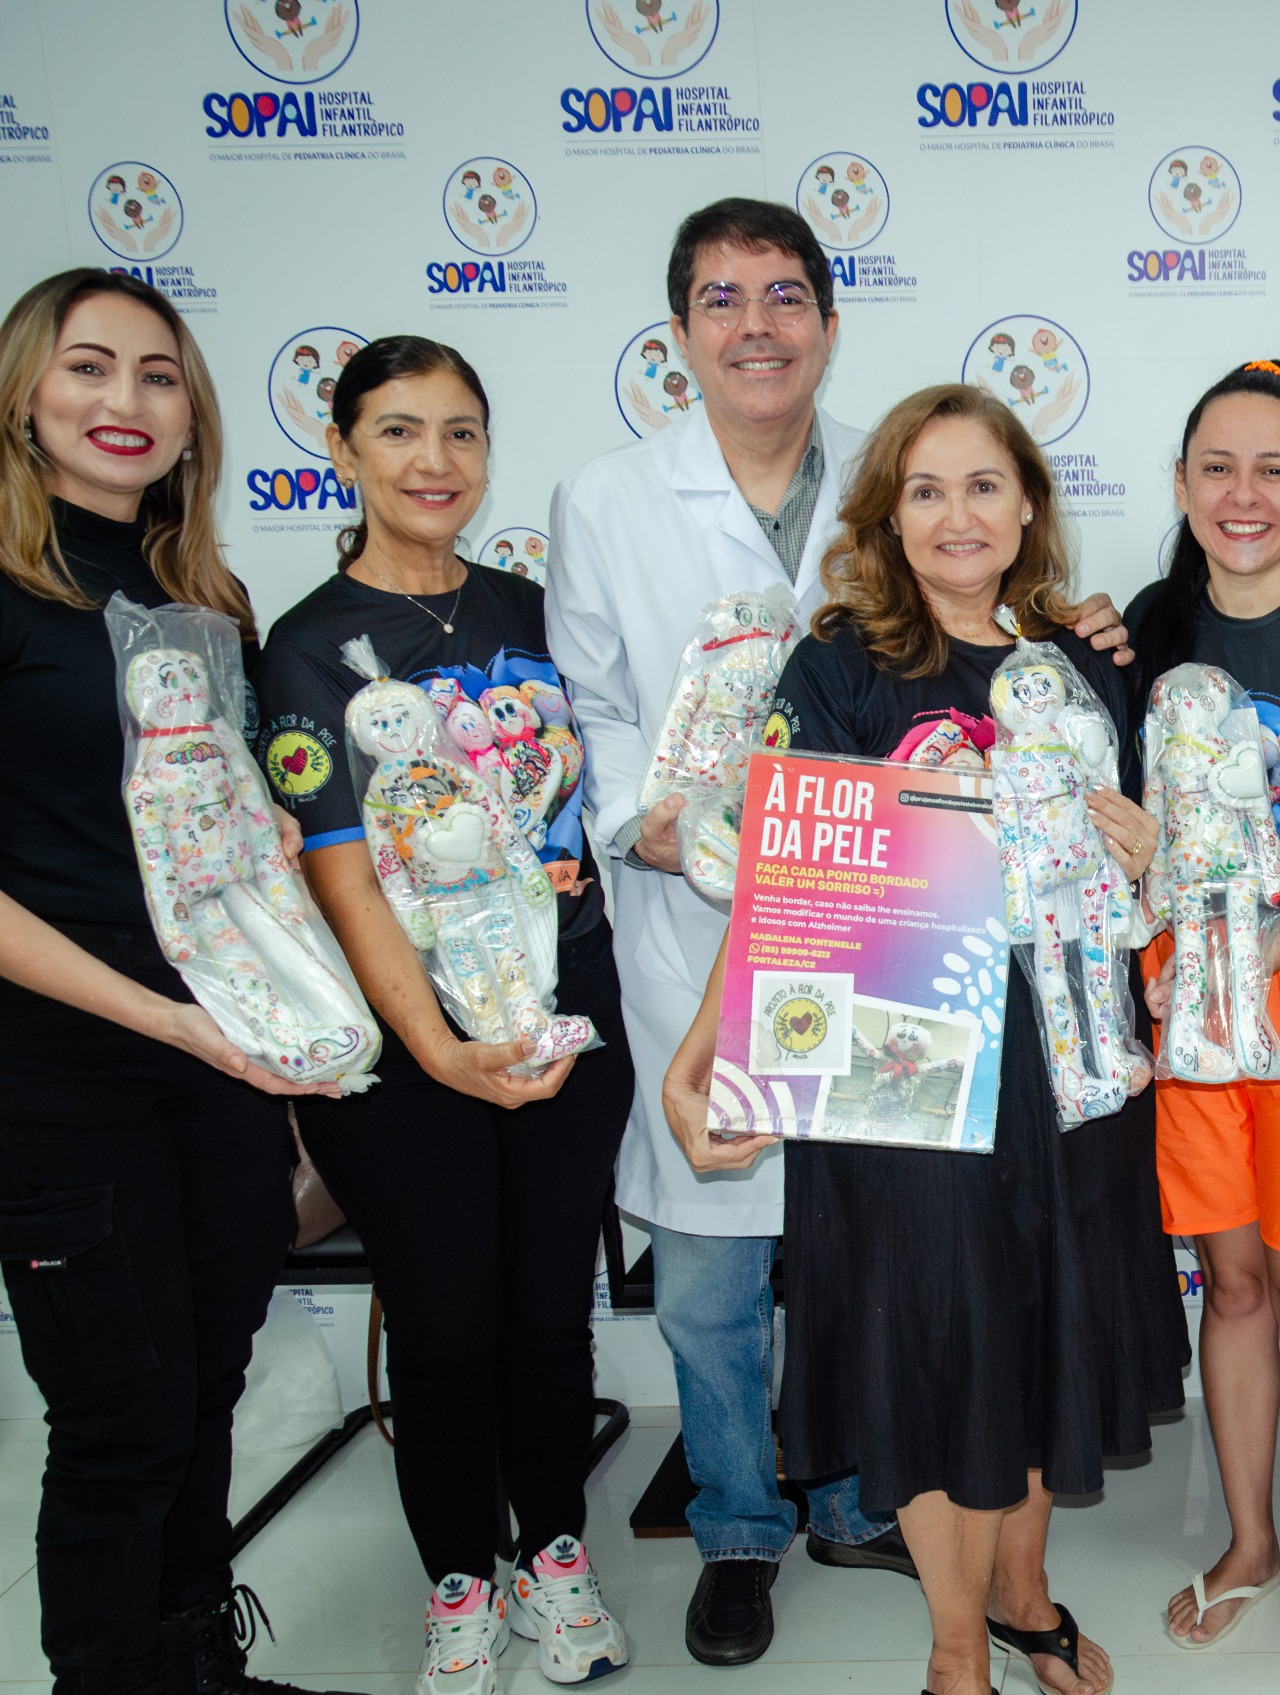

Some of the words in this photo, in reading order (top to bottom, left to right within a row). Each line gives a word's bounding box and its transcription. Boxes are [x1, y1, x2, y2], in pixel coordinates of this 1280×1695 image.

[676, 86, 730, 100] HOSPITAL
[1032, 81, 1086, 94] HOSPITAL
[319, 91, 374, 106] HOSPITAL
[917, 81, 1027, 127] SOPAI
[1032, 98, 1084, 110] INFANTIL
[203, 92, 318, 138] SOPAI
[320, 107, 372, 120] INFANTIL
[561, 87, 673, 132] SOPAI
[678, 103, 728, 115] INFANTIL
[679, 114, 760, 131] FILANTRÓPICO
[1033, 109, 1114, 126] FILANTRÓPICO
[322, 119, 404, 137] FILANTRÓPICO
[572, 147, 599, 155] MAIOR
[600, 147, 635, 155] HOSPITAL
[636, 147, 648, 155] DE
[648, 146, 690, 155] PEDIATRIA
[690, 145, 721, 154] CLÍNICA
[722, 146, 735, 154] DO
[735, 145, 760, 154] BRASIL
[927, 143, 953, 151] MAIOR
[954, 142, 990, 151] HOSPITAL
[991, 142, 1002, 150] DE
[1003, 141, 1044, 150] PEDIATRIA
[1044, 140, 1075, 149] CLÍNICA
[1076, 141, 1088, 149] DO
[1089, 140, 1114, 149] BRASIL
[858, 255, 896, 265] HOSPITAL
[1208, 249, 1247, 259] HOSPITAL
[156, 266, 195, 276] HOSPITAL
[507, 261, 546, 271] HOSPITAL
[859, 267, 894, 275] INFANTIL
[1127, 249, 1205, 282] SOPAI
[1208, 260, 1245, 270] INFANTIL
[426, 261, 505, 294] SOPAI
[508, 272, 545, 281] INFANTIL
[860, 274, 917, 286] FILANTRÓPICO
[1208, 269, 1266, 280] FILANTRÓPICO
[157, 278, 194, 287] INFANTIL
[509, 280, 566, 292] FILANTRÓPICO
[286, 524, 320, 532] HOSPITAL
[279, 713, 298, 728] FLOR
[301, 717, 314, 731] DA
[318, 728, 336, 748] PELE
[764, 763, 786, 812] À
[796, 775, 874, 821] FLOR
[760, 816, 802, 860] DA
[812, 822, 890, 868] PELE
[756, 862, 788, 876] FAÇA
[791, 866, 824, 879] CADA
[827, 869, 867, 883] PONTO
[870, 874, 928, 889] BORDADO
[755, 874, 794, 887] VALER
[797, 878, 815, 889] UM
[818, 880, 871, 895] SORRISO
[754, 893, 781, 903] Venha
[783, 894, 813, 907] bordar,
[815, 899, 834, 908] caso
[836, 902, 852, 910] não
[854, 903, 875, 912] saiba
[878, 905, 890, 914] lhe
[893, 908, 939, 919] ensinamos.
[753, 904, 781, 914] Vamos
[783, 906, 823, 919] modificar
[834, 913, 864, 923] mundo
[866, 915, 876, 923] de
[899, 919, 929, 929] criança
[931, 922, 986, 934] hospitalizada
[759, 916, 786, 926] idosos
[788, 920, 806, 928] com
[808, 921, 851, 932] Alzheimer
[750, 932, 802, 944] MADALENA
[804, 937, 862, 950] FONTENELLE
[747, 955, 816, 968] FORTALEZA/CE
[764, 989, 787, 1017] PROJETO
[798, 984, 813, 995] FLOR
[815, 988, 825, 1001] DA
[824, 1000, 836, 1017] PELE
